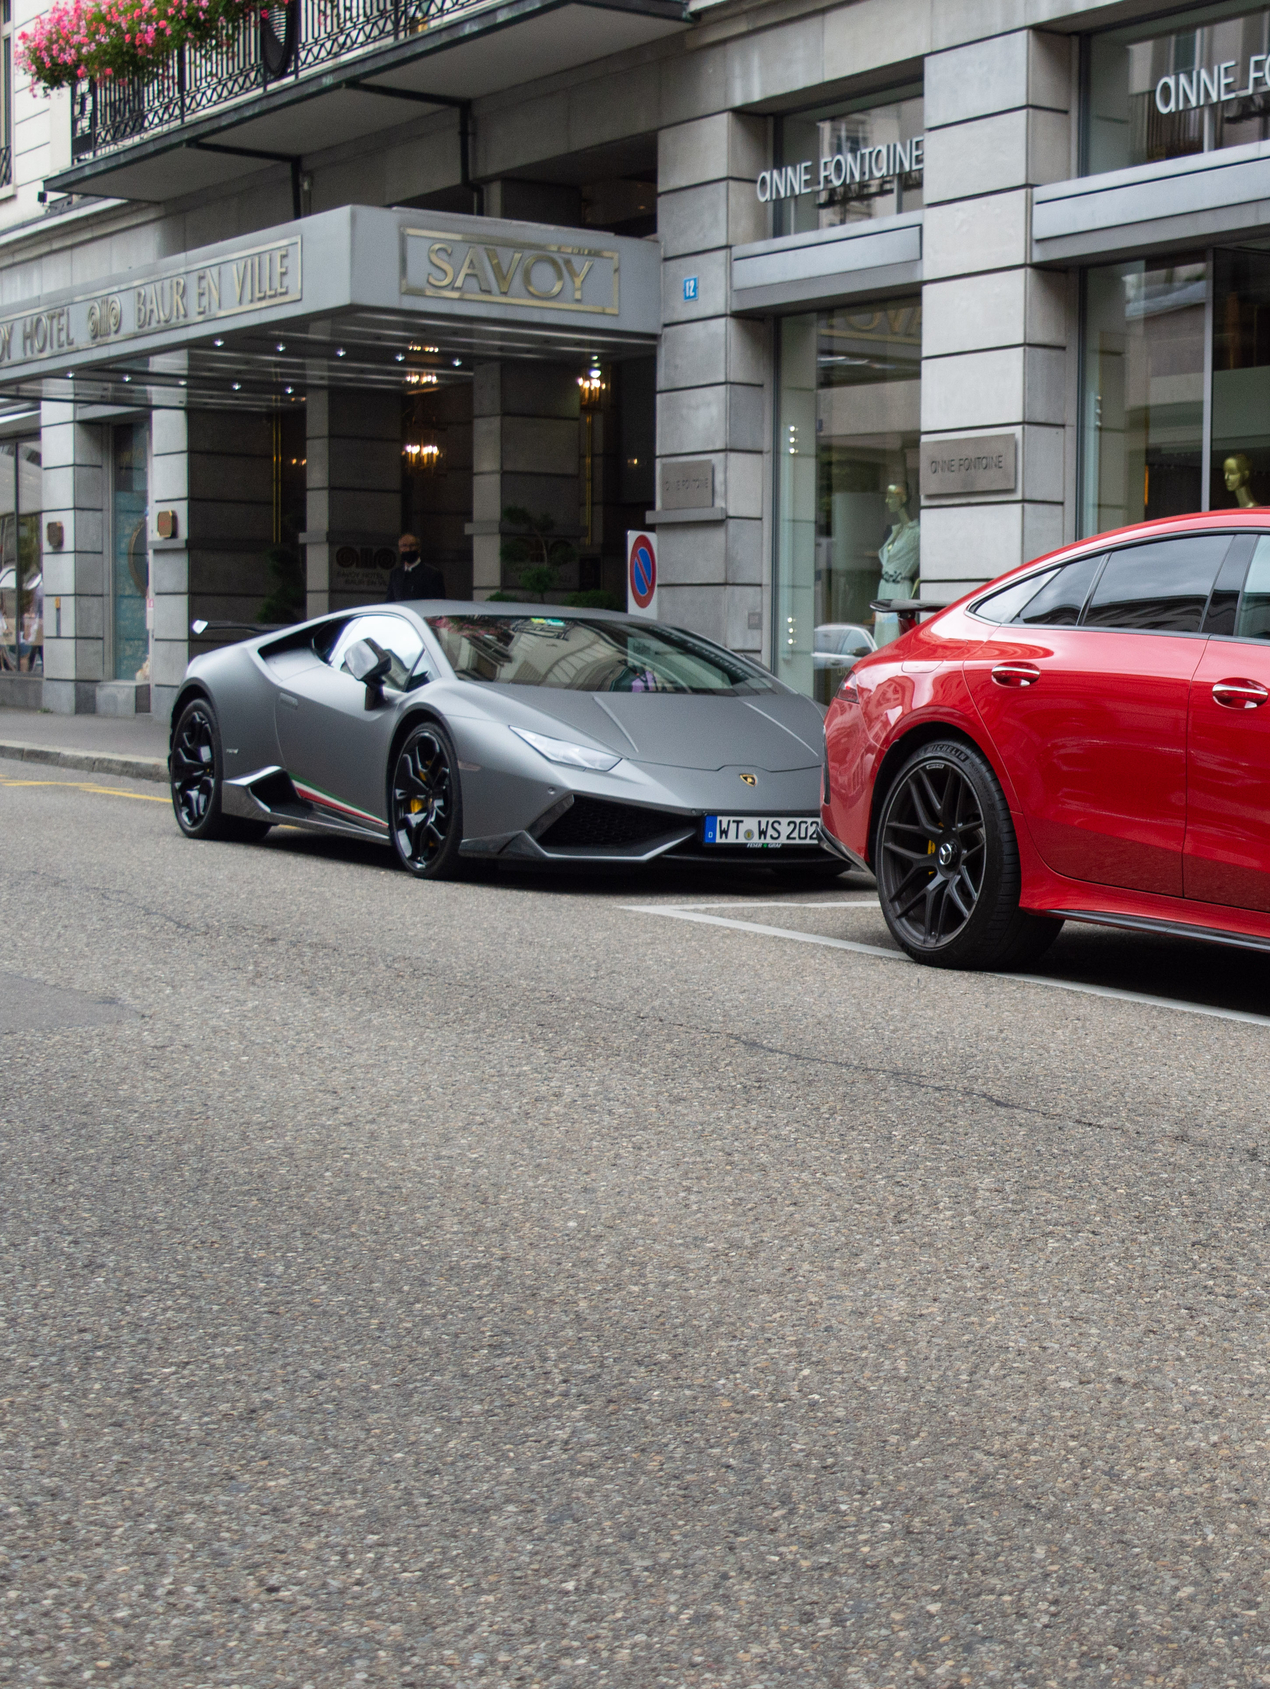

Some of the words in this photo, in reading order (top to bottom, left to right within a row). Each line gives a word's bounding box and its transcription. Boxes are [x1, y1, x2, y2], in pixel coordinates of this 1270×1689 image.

[427, 243, 594, 301] SAVOY
[685, 280, 696, 298] 12
[22, 307, 75, 353] HOTEL
[135, 277, 188, 329] BAUR
[196, 266, 222, 315] EN
[232, 249, 289, 304] VILLE
[926, 744, 968, 761] MICHELIN
[718, 819, 744, 840] WT
[758, 820, 781, 840] WS
